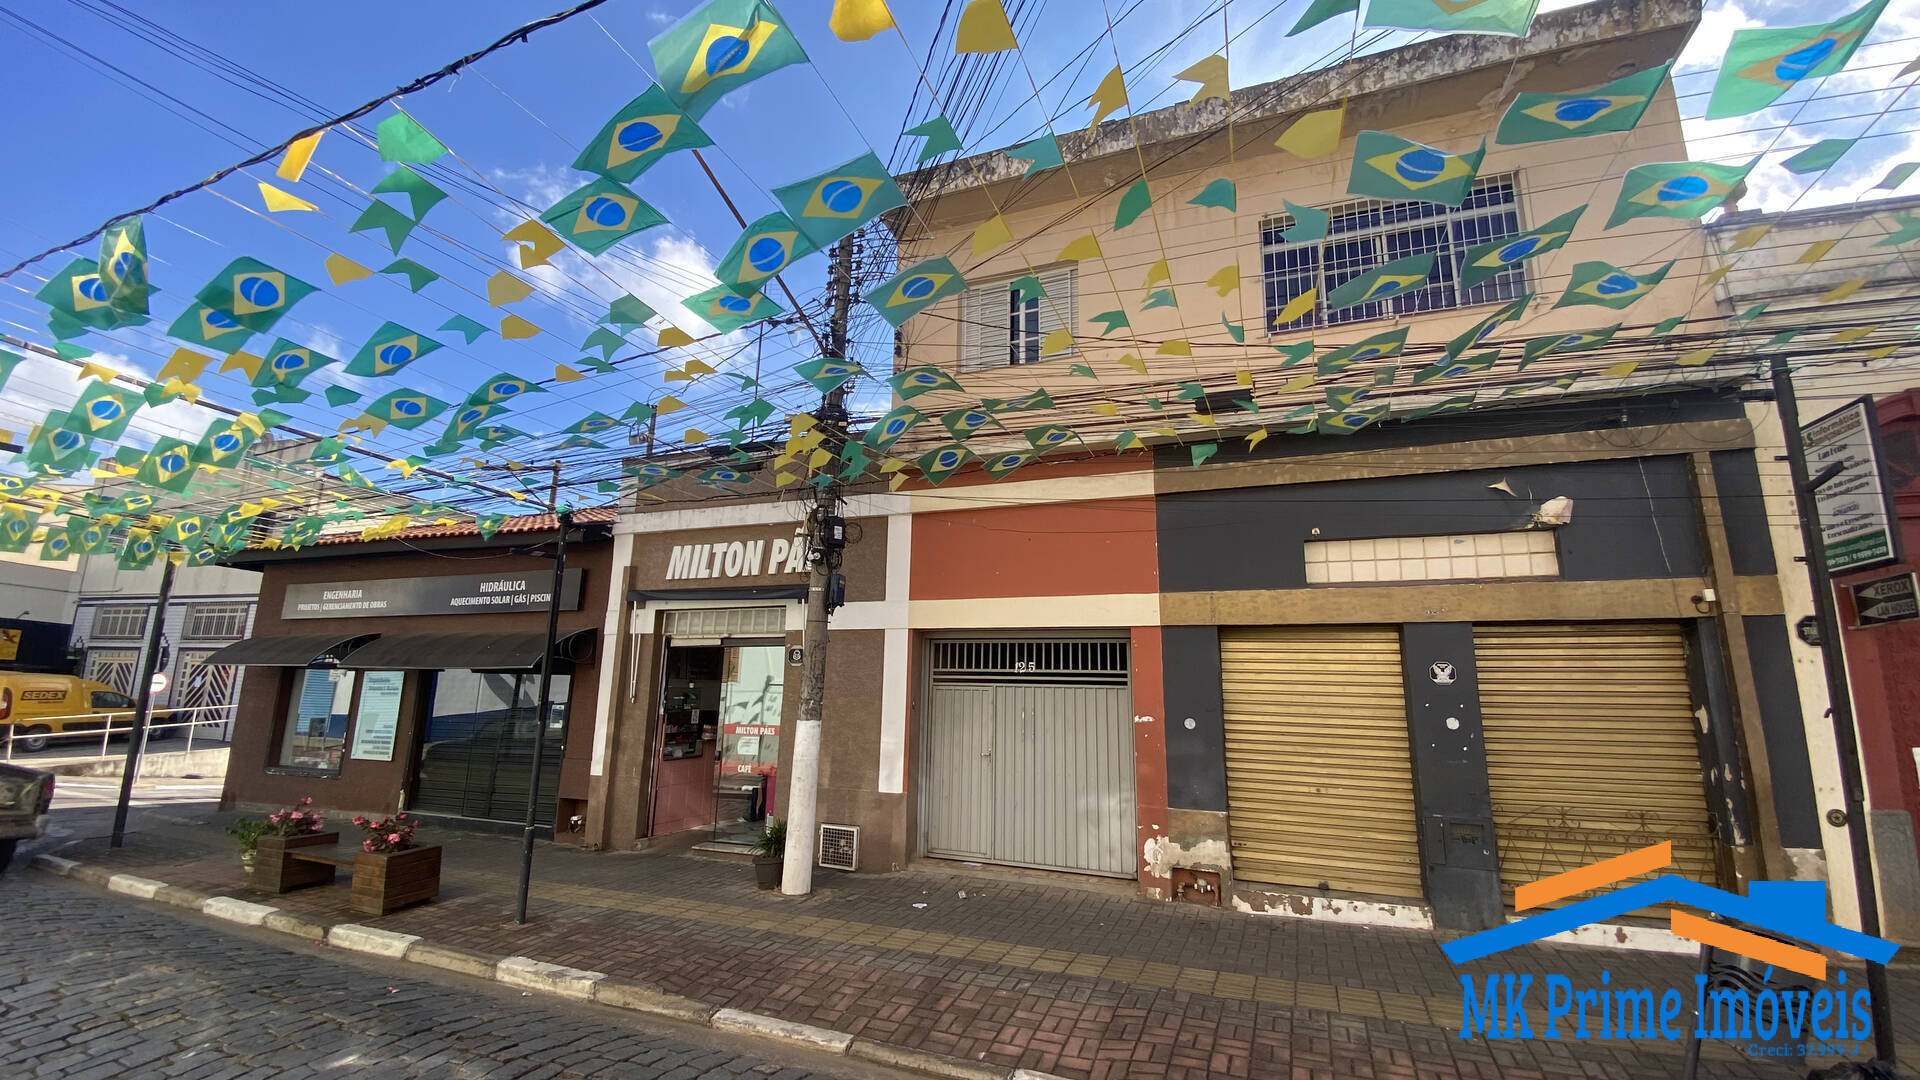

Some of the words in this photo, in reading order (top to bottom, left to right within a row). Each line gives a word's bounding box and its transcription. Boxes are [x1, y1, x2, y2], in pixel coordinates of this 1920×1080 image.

[665, 540, 764, 580] MILTON
[480, 580, 526, 592] HIDRÁULICA
[1872, 579, 1910, 597] XEROX
[323, 590, 363, 600] ENGENHARIA
[450, 597, 491, 606] AQUECIMENTO
[491, 595, 511, 604] SOLAR
[514, 593, 526, 603] GÁS
[323, 602, 363, 610] GERENCIAMENTO
[363, 601, 369, 609] DE
[370, 600, 388, 608] OBRAS
[1015, 661, 1035, 673] 125
[23, 691, 65, 700] SEDEX
[736, 726, 759, 735] MILTON
